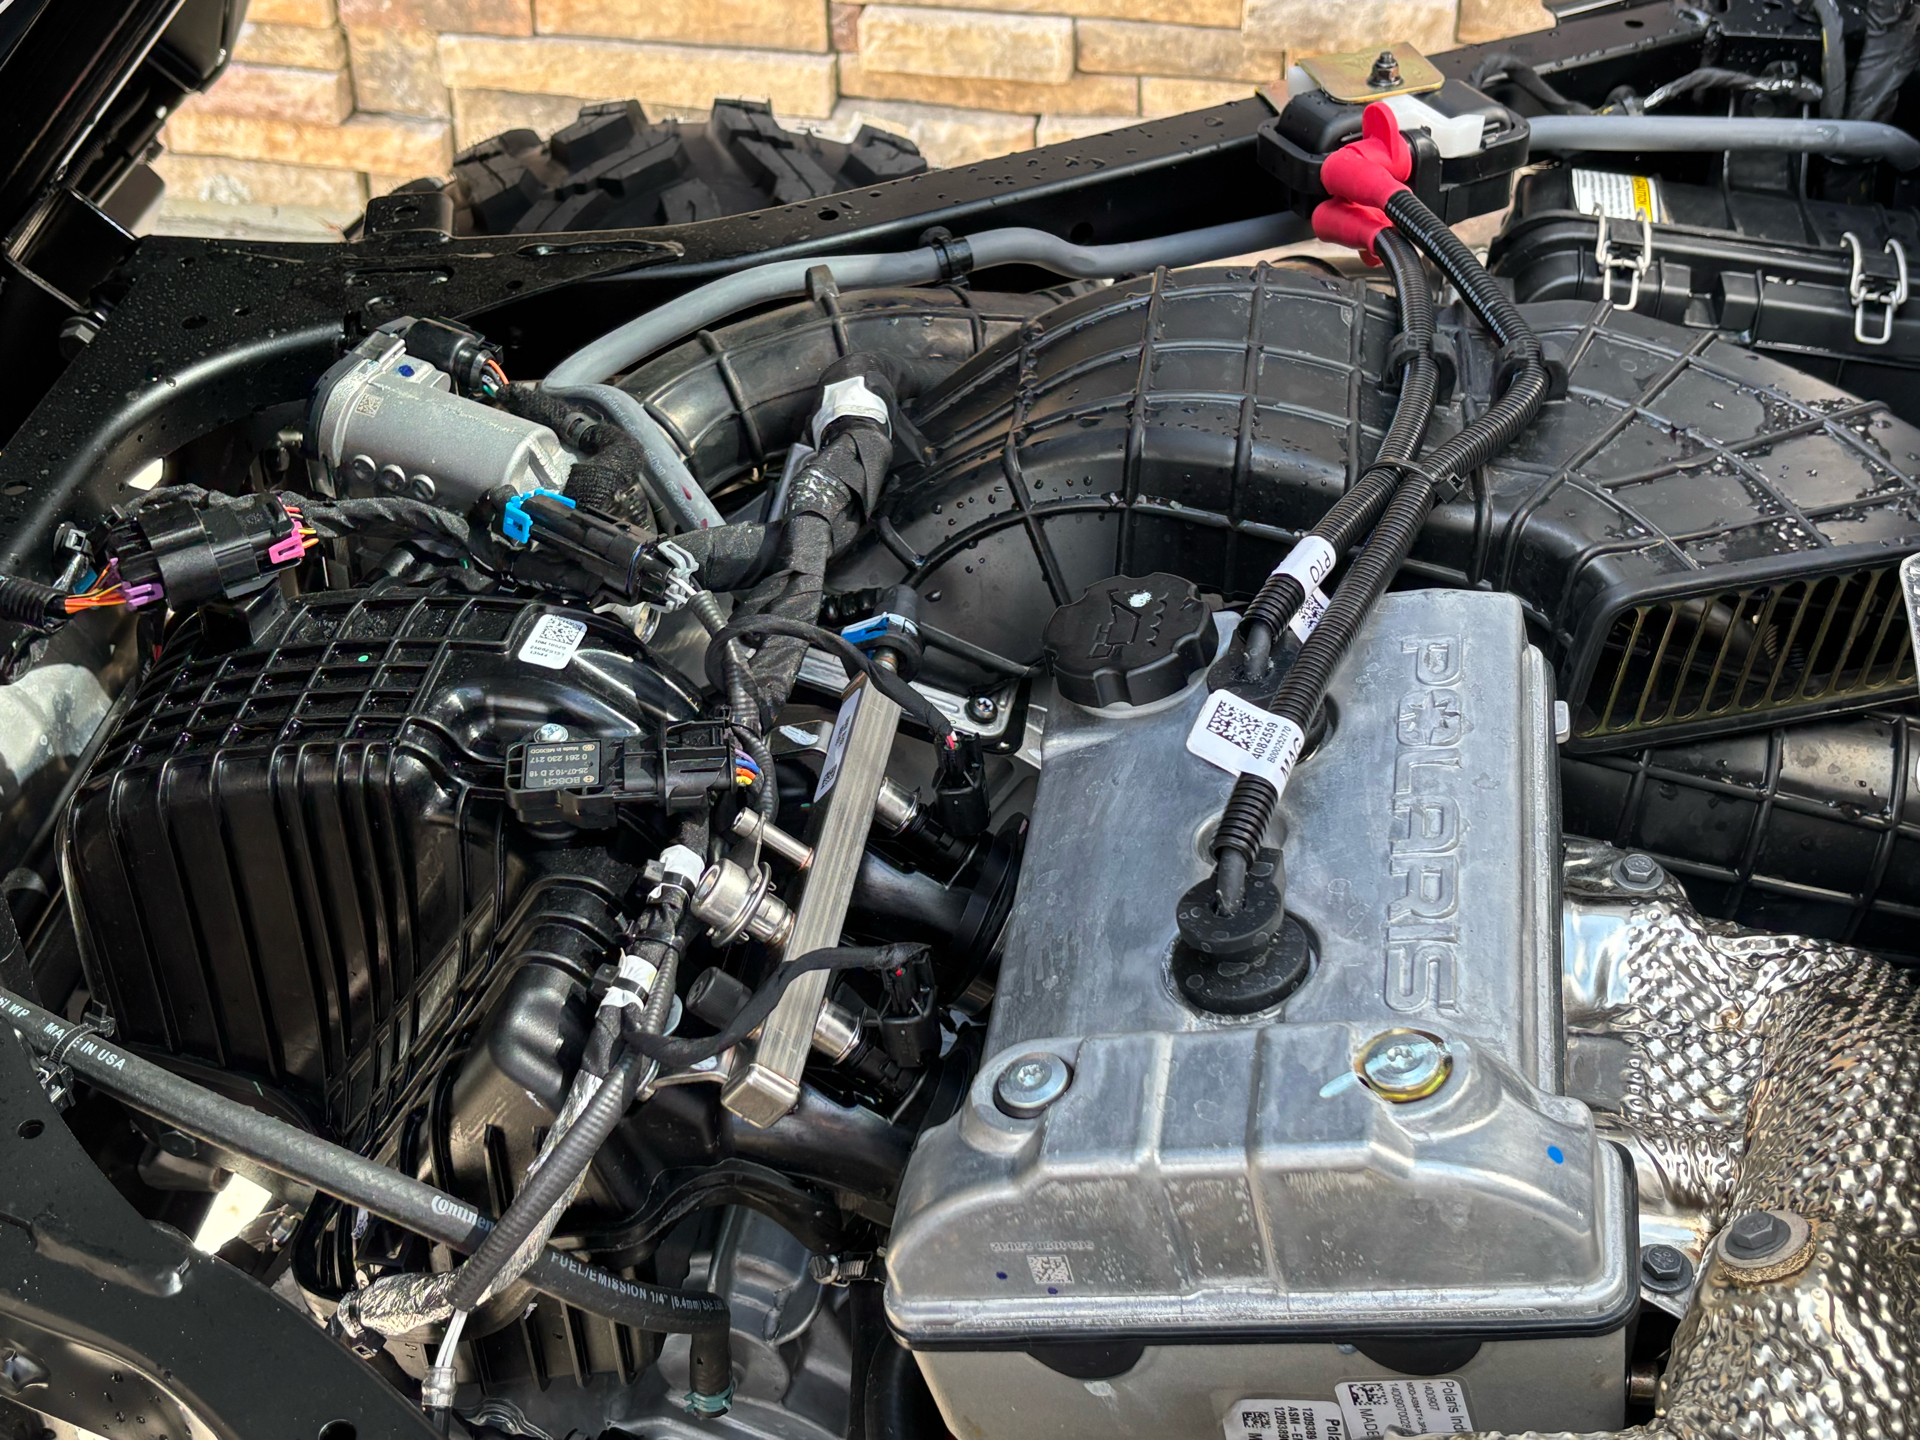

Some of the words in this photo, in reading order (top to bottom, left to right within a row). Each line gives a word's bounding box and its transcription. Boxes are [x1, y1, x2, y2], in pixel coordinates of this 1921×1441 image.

[1309, 550, 1332, 584] PTO
[1252, 722, 1279, 760] 4082559
[1267, 725, 1292, 764] B000252170
[530, 756, 545, 764] 217
[547, 755, 562, 763] 230
[543, 776, 580, 786] BOSCH
[1384, 633, 1464, 1013] POLARIS
[8, 1003, 30, 1018] WP
[80, 1040, 98, 1056] IN
[97, 1049, 126, 1071] USA
[431, 1195, 496, 1232] Continen
[550, 1251, 647, 1300] FUEL/EMISSION
[1422, 1381, 1440, 1411] 1400907
[1440, 1381, 1459, 1413] Polaris
[1450, 1415, 1468, 1433] Ind
[1274, 1407, 1290, 1441] 1209389
[1287, 1406, 1301, 1424] ASM
[1359, 1408, 1380, 1437] MADE
